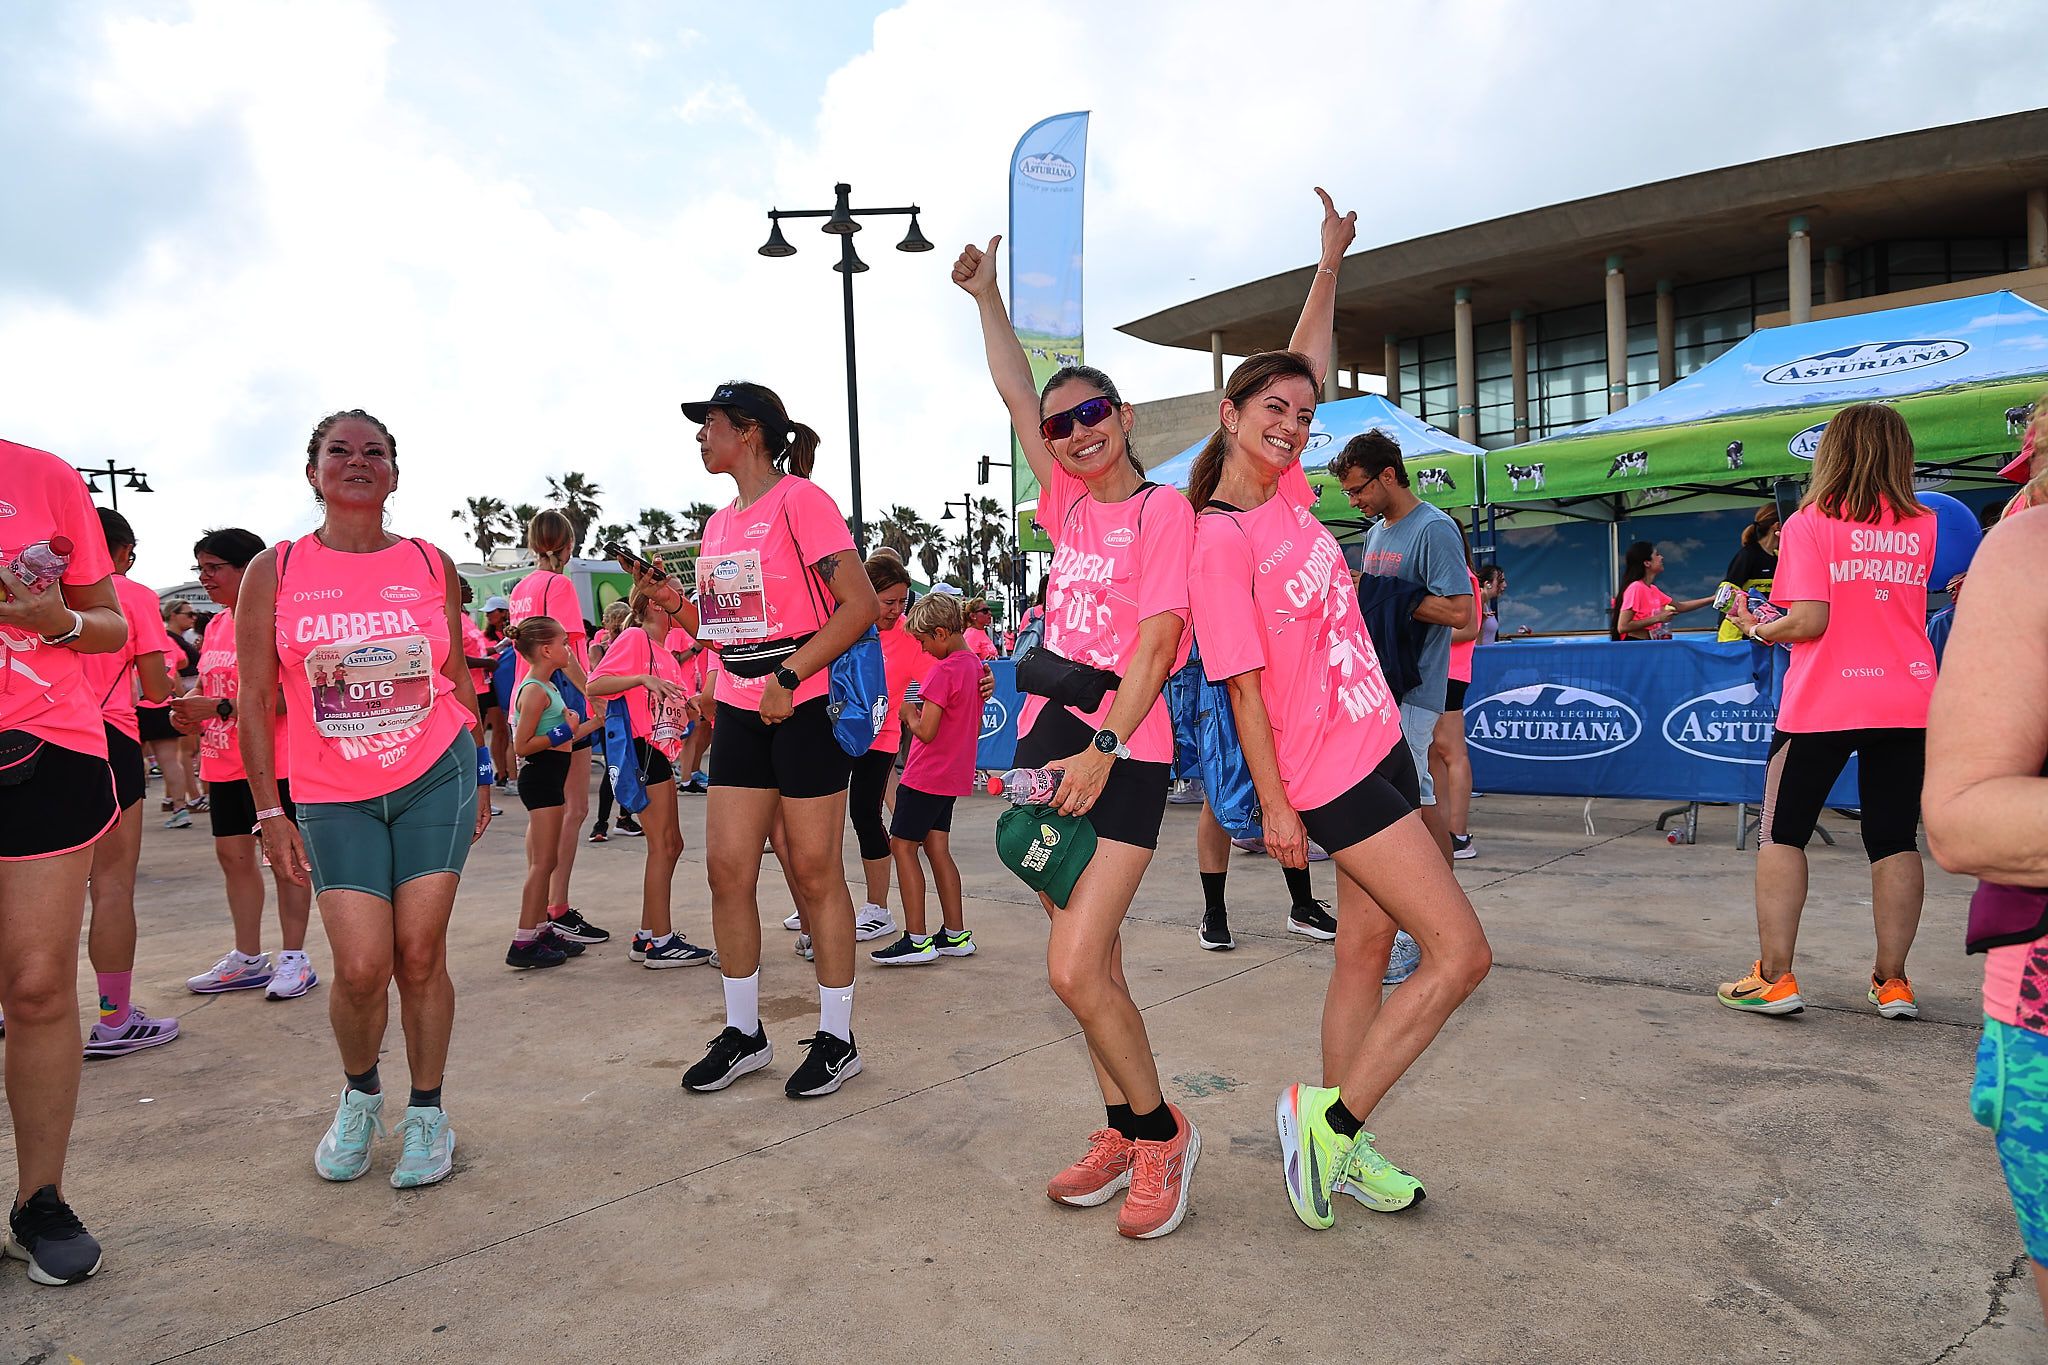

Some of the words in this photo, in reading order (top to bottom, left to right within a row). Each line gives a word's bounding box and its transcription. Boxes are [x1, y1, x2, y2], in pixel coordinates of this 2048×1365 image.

[1022, 160, 1072, 178] ASTURIANA
[1778, 348, 1952, 381] ASTURIANA
[1851, 529, 1920, 557] SOMOS
[1259, 539, 1294, 574] OYSHO
[1829, 558, 1928, 587] MPARABLE
[294, 588, 343, 602] OYSHO
[717, 593, 742, 608] 016
[1065, 591, 1096, 634] DE
[708, 626, 729, 635] OYSHO
[347, 655, 393, 665] ASTURIANA
[1841, 667, 1884, 678] OYSHO
[349, 680, 395, 700] 016
[324, 711, 351, 719] CARRERA
[352, 710, 360, 718] DE
[370, 708, 390, 717] MUJER
[394, 704, 421, 713] VALENCIA
[366, 700, 381, 709] 129
[666, 707, 682, 718] 016
[1498, 709, 1554, 718] CENTRAL
[1560, 709, 1621, 718] LECHERA
[327, 723, 365, 732] OYSHO
[1469, 710, 1626, 742] ASTURIANA
[378, 744, 408, 769] 2026
